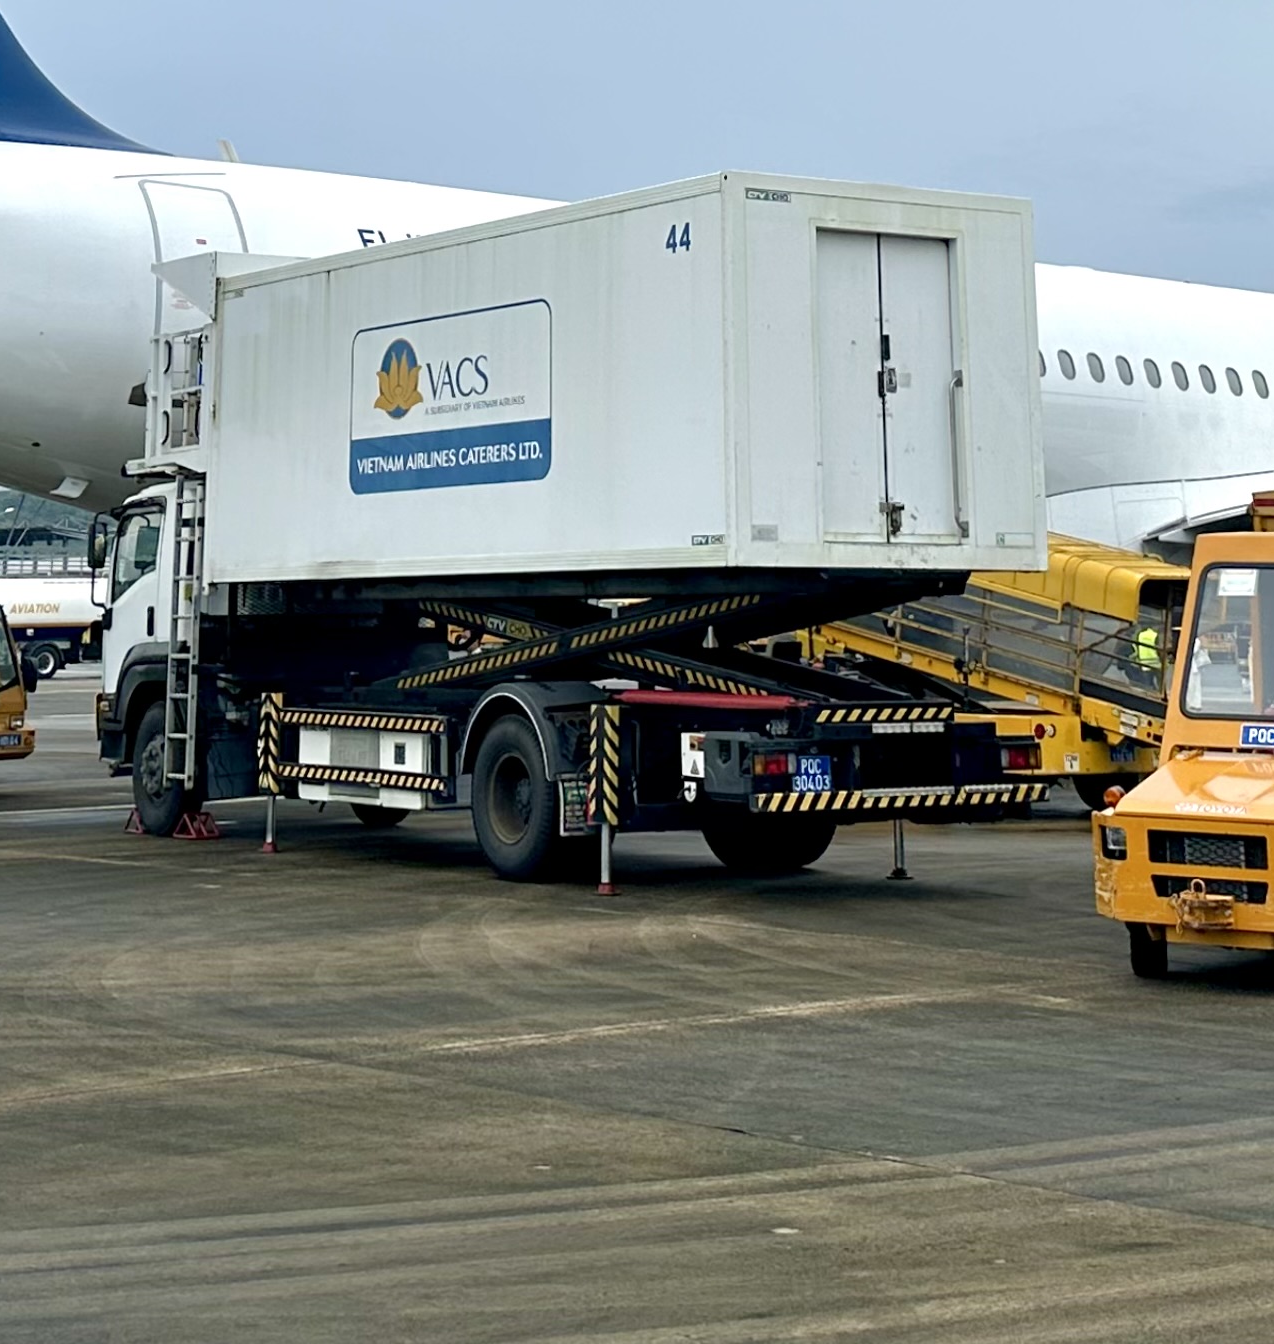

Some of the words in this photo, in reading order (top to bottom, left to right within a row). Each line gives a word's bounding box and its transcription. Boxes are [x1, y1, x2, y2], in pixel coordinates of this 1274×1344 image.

[665, 221, 692, 254] 44
[425, 354, 489, 401] VACS
[356, 455, 405, 475] VIETNAM
[405, 449, 456, 471] AIRLINES
[458, 443, 517, 467] CATERERS
[518, 440, 543, 461] LTD.
[10, 603, 60, 615] AVIATION
[1194, 803, 1248, 814] TOYOTA
